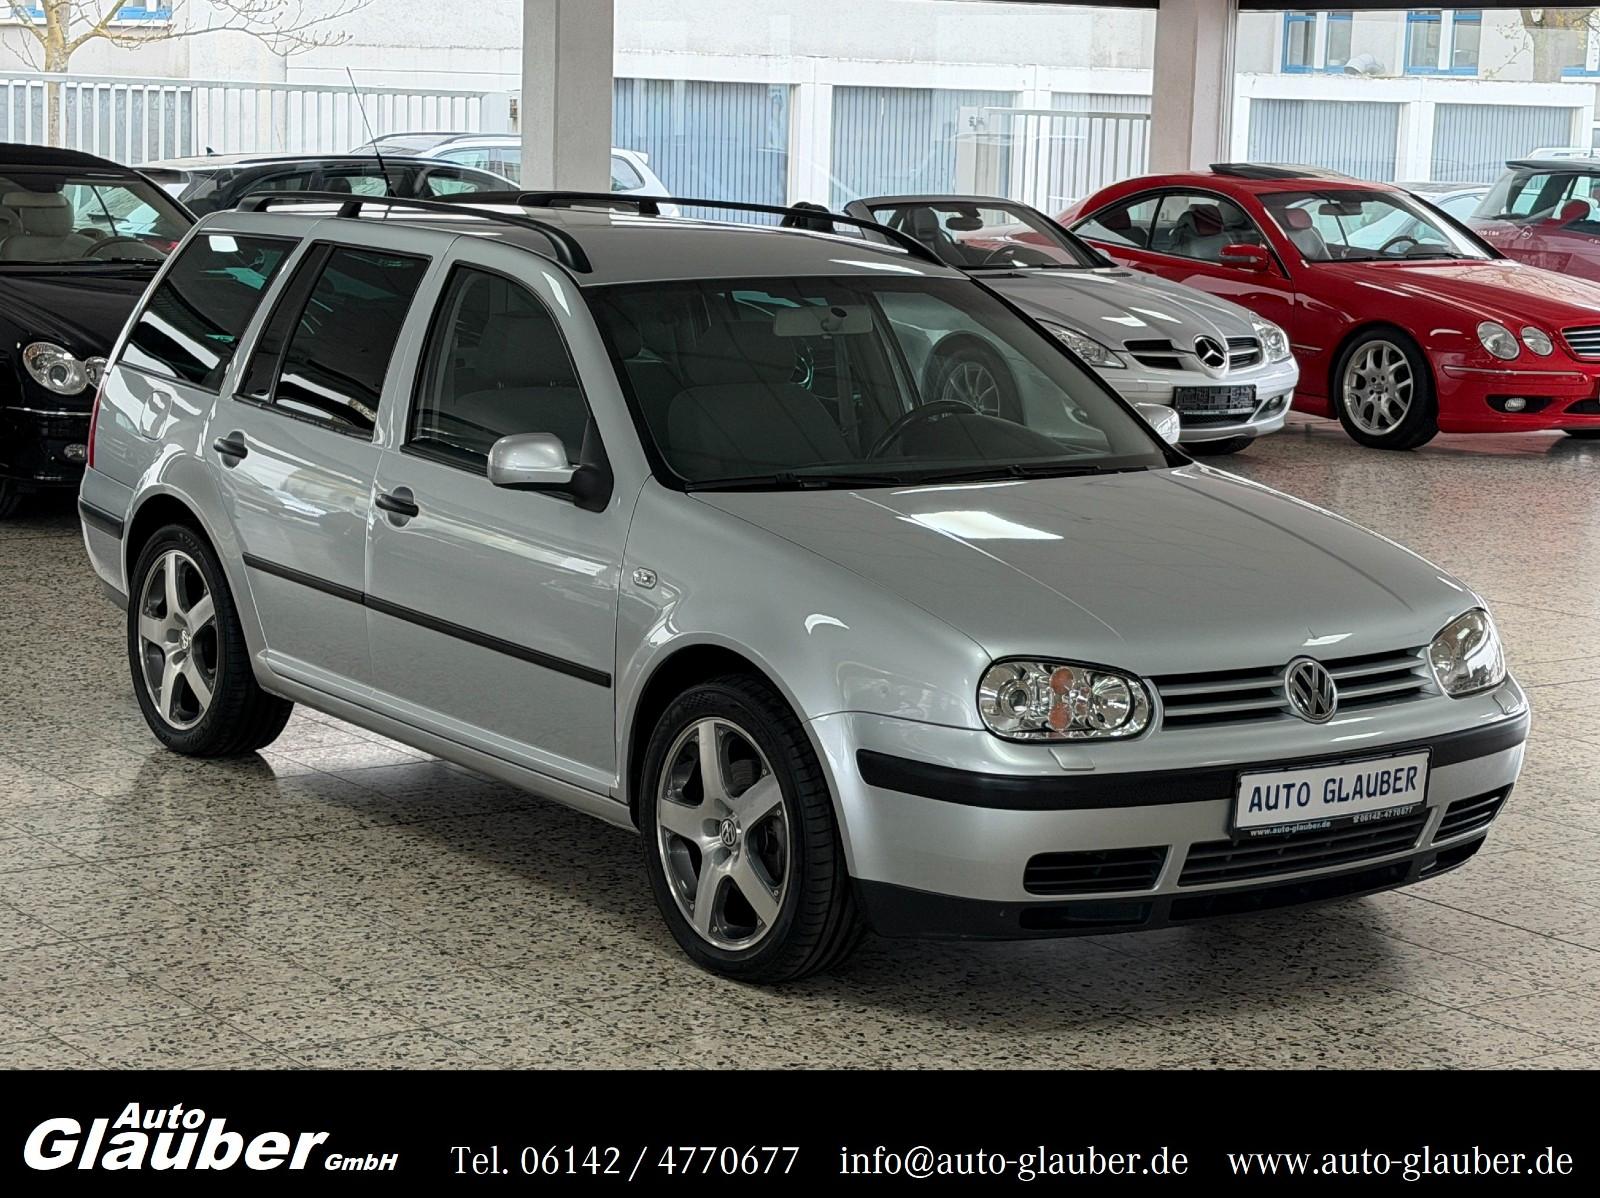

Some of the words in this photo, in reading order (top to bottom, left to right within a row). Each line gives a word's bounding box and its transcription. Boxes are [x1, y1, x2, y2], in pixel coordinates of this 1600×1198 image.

[1286, 658, 1337, 721] VW
[1248, 781, 1311, 813] AUTO
[1323, 765, 1418, 804] GLAUBER
[1250, 820, 1331, 837] www.auto-glauber.de
